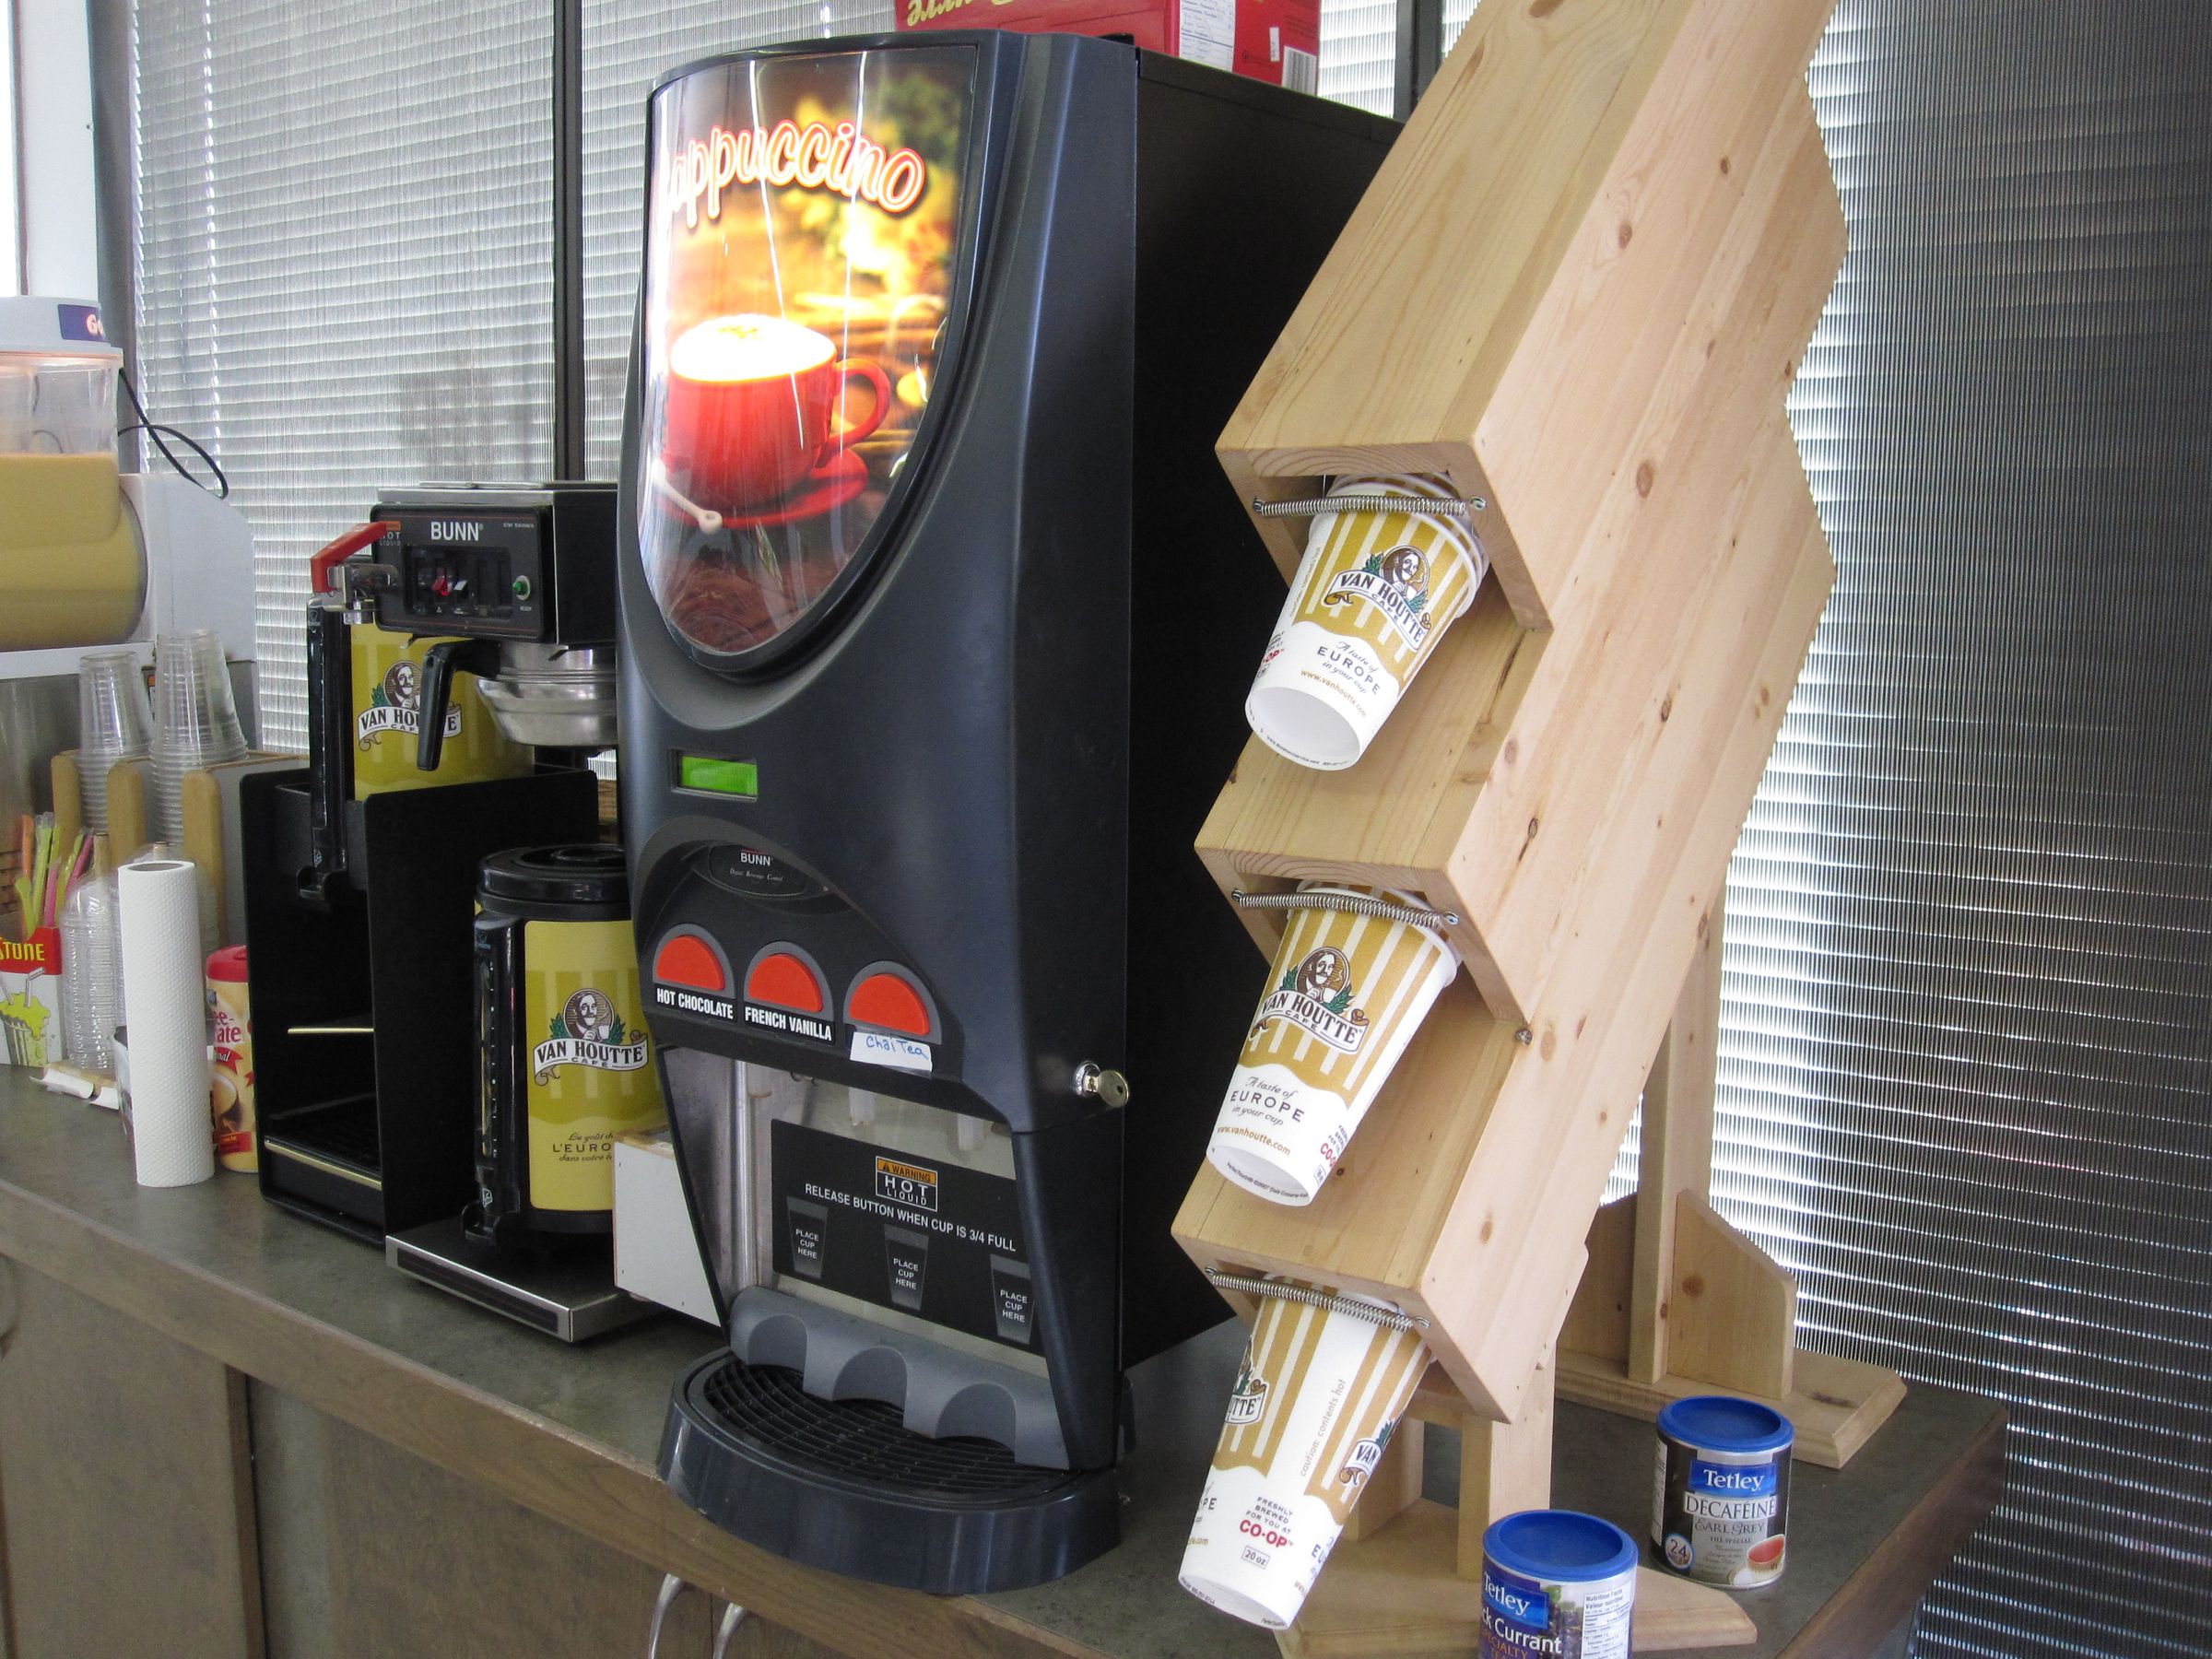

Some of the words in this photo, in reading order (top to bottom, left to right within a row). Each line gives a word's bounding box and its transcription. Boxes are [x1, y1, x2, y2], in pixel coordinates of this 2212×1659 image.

[667, 120, 925, 229] appuccino
[430, 521, 479, 541] BUNN
[1340, 573, 1375, 589] VAN
[1378, 583, 1423, 642] HOUTTE
[1317, 646, 1382, 695] EUROPE
[361, 709, 387, 730] VAN
[394, 708, 458, 732] HOE
[740, 852, 771, 866] BUNN
[656, 987, 677, 1006] HOT
[677, 993, 735, 1020] CHOCOLATE
[744, 1006, 787, 1030] FRENCH
[789, 1015, 832, 1041] VANILLA
[1262, 993, 1288, 1014] VAN
[1291, 994, 1359, 1044] HOUTTE
[536, 1041, 567, 1064] VAN
[574, 1041, 643, 1065] HOUTTE
[866, 1034, 896, 1052] Chai
[895, 1039, 930, 1060] Tea
[1257, 1080, 1282, 1094] taste
[1281, 1089, 1300, 1100] of
[1230, 1090, 1305, 1124] EUROPE
[552, 1143, 612, 1153] L'EURO
[1217, 1125, 1292, 1157] www.vanhoutte.com
[891, 1165, 931, 1182] WARNING
[885, 1175, 928, 1197] HOT
[887, 1187, 927, 1206] LIQUID
[805, 1182, 851, 1206] RELEASE
[853, 1197, 895, 1218] BUTTON
[897, 1208, 929, 1228] WHEN
[931, 1218, 954, 1235] CUP
[956, 1225, 967, 1238] IS
[969, 1229, 985, 1243] 3/4
[987, 1233, 1017, 1253] FULL
[795, 1228, 819, 1242] PLACE
[799, 1238, 816, 1249] CUP
[797, 1247, 818, 1260] HERE
[893, 1257, 919, 1272] PLACE
[898, 1268, 914, 1279] CUP
[895, 1277, 917, 1290] HERE
[1000, 1288, 1028, 1304] PLACE
[1005, 1300, 1023, 1312] CUP
[1002, 1310, 1026, 1324] HERE
[1356, 1444, 1380, 1466] VAN
[1703, 1468, 1765, 1492] Tetley
[1254, 1505, 1288, 1524] BREWED
[1257, 1497, 1293, 1516] FRESHLY
[1245, 1511, 1262, 1521] FOR
[1265, 1518, 1280, 1529] YOU
[1694, 1518, 1729, 1534] EARL
[1731, 1521, 1764, 1535] GREY
[1239, 1519, 1288, 1548] CO-OP
[1244, 1549, 1256, 1560] 20
[1256, 1557, 1266, 1566] oz
[1670, 1539, 1688, 1559] 24
[1484, 1571, 1531, 1617] Tetley
[1494, 1617, 1564, 1654] Currant
